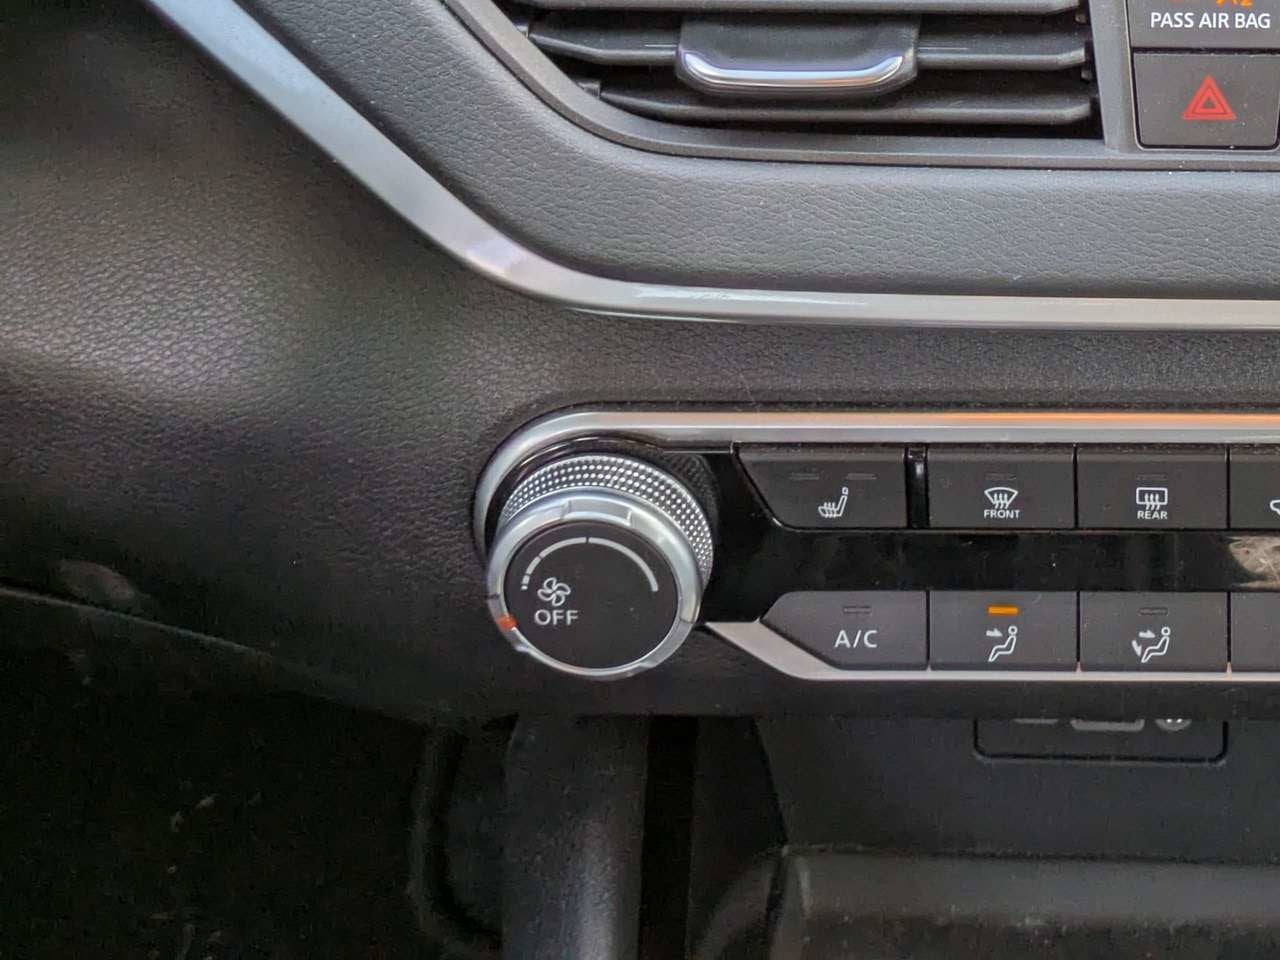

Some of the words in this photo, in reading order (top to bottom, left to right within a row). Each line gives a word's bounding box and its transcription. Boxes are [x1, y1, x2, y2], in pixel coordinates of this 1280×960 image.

[1150, 11, 1195, 28] PASS
[1198, 12, 1230, 29] AIR
[1234, 12, 1271, 29] BAG
[983, 508, 1020, 519] FRONT
[1137, 510, 1168, 520] REAR
[534, 609, 578, 626] OFF
[834, 629, 878, 649] A/C
